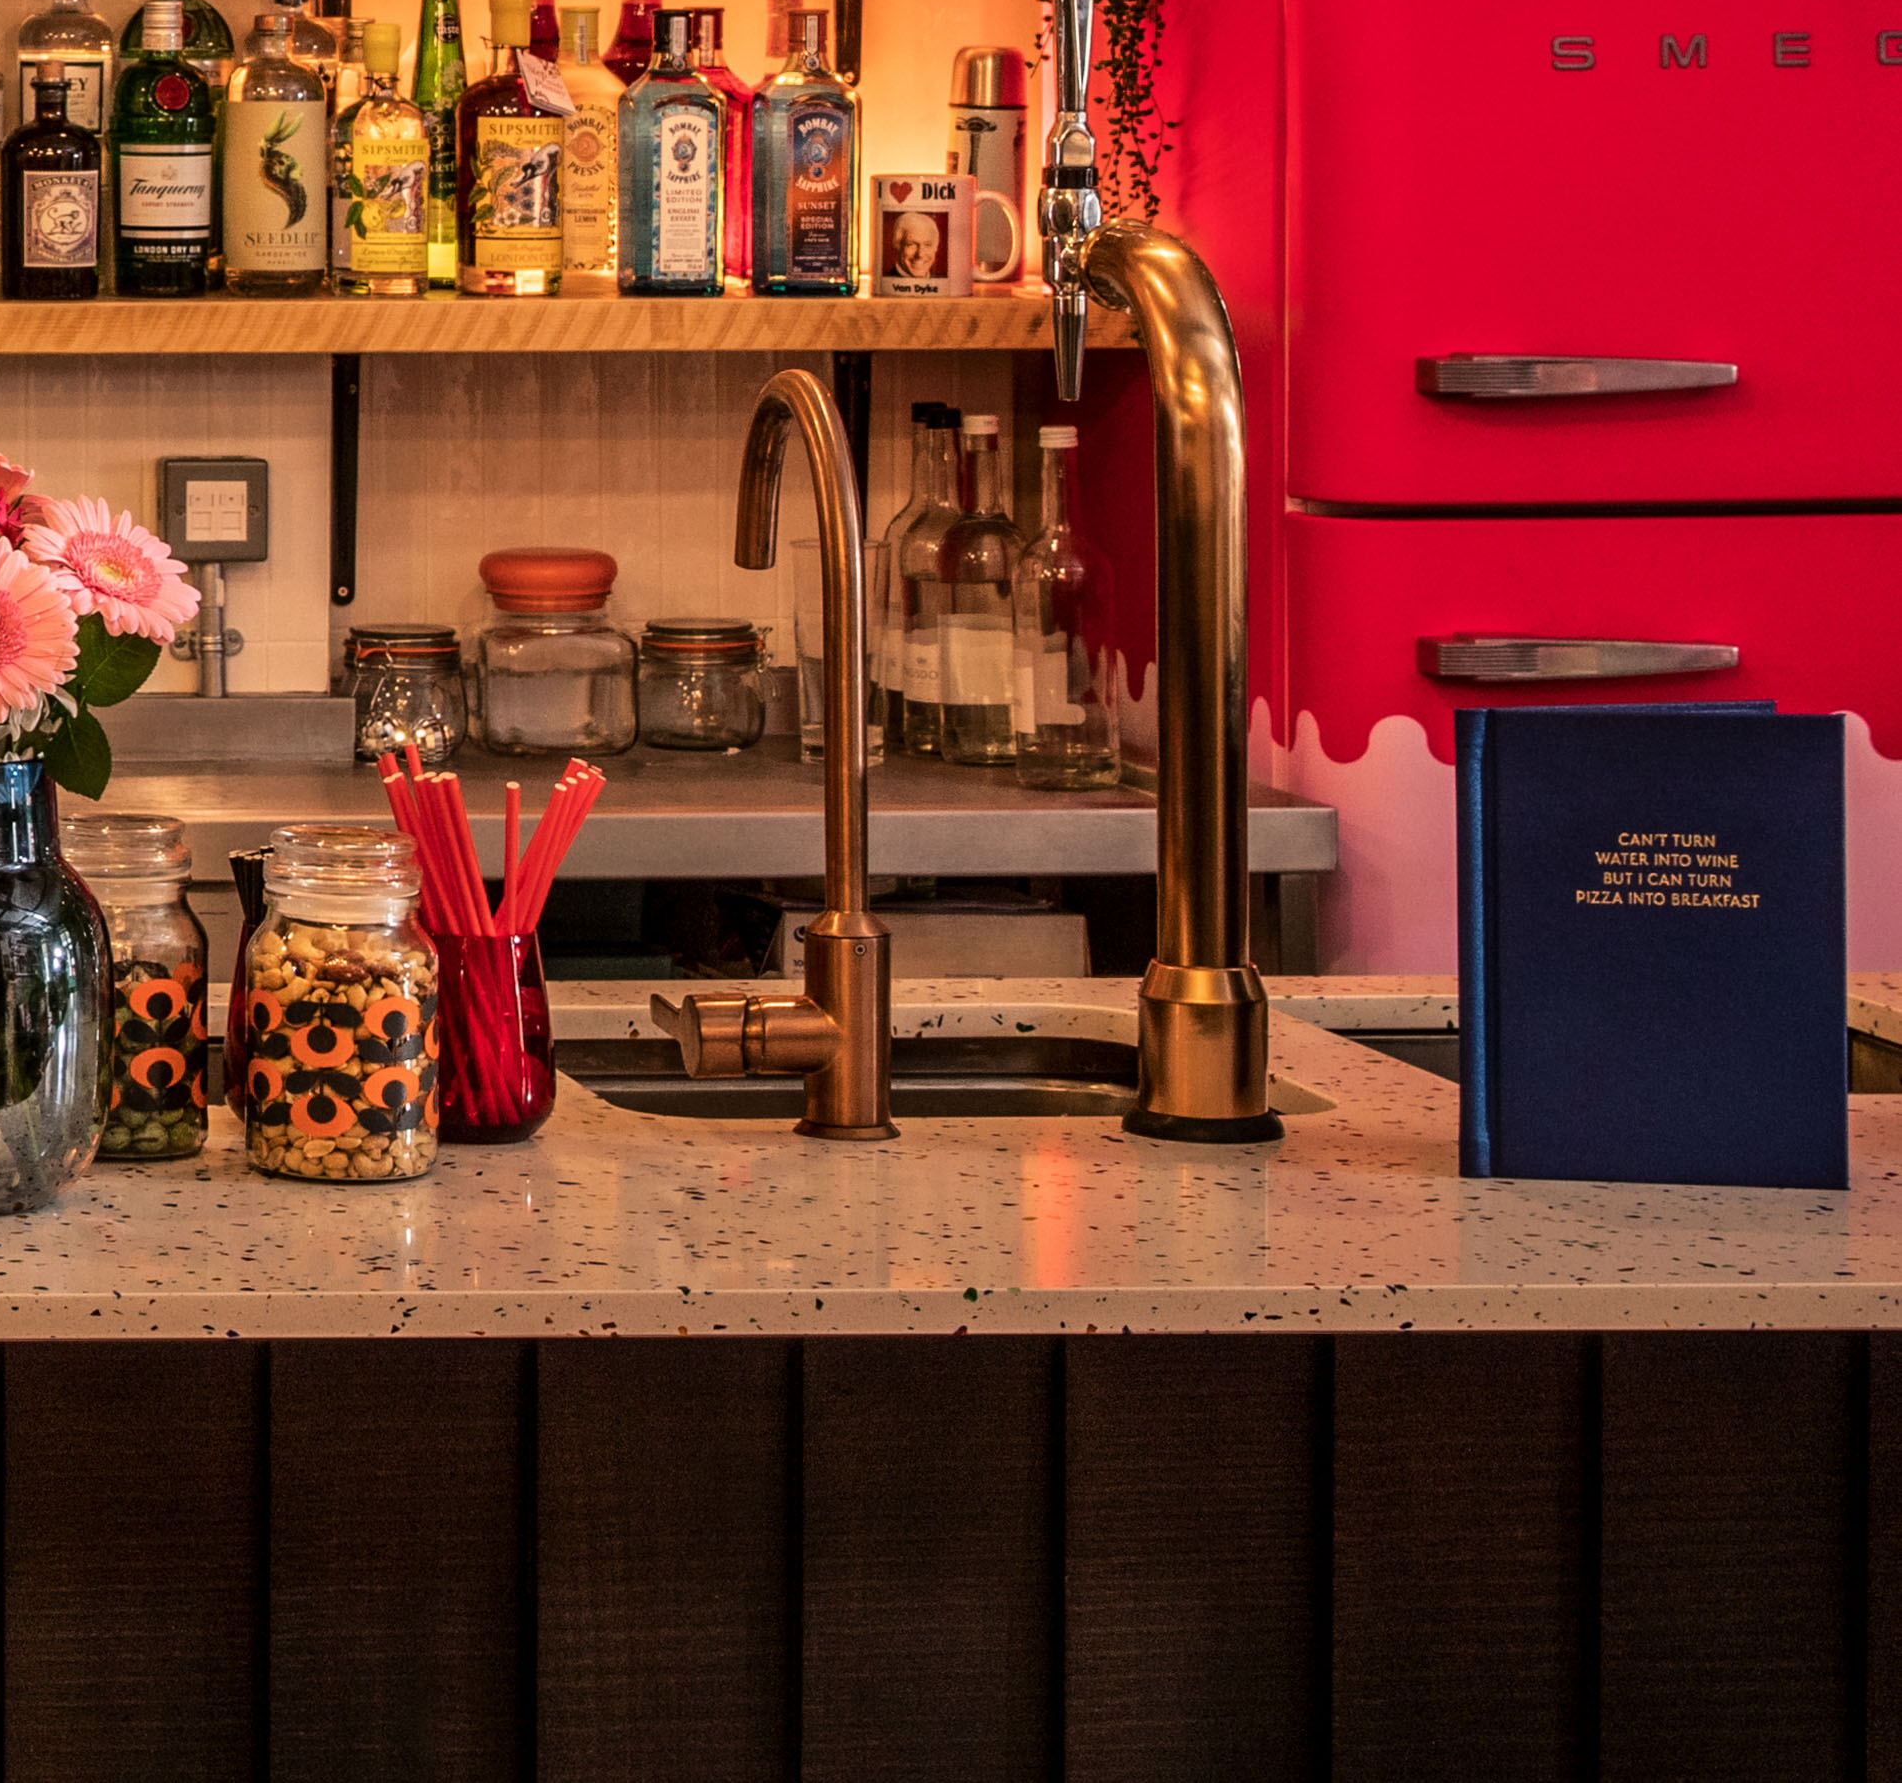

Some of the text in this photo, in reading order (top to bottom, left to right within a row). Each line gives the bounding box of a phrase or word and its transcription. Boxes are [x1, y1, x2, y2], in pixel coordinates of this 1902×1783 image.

[1551, 30, 1902, 71] SMEG
[488, 123, 562, 137] SIPSMITH
[566, 117, 607, 136] BOMBAY
[667, 120, 701, 137] BOMBAY
[796, 118, 839, 138] BOMBAY
[360, 144, 425, 157] SIPSMITH
[666, 170, 703, 185] SAPPHIRE
[128, 176, 208, 200] Tanqueray
[665, 189, 702, 197] LIMITED
[794, 177, 840, 197] SAPPHIRE
[878, 181, 956, 201] I Dick
[665, 198, 702, 206] EDITION
[796, 200, 838, 211] SUNSET
[666, 207, 700, 215] ENGLISH
[574, 216, 597, 224] LEMON
[799, 223, 836, 231] EDITION
[243, 229, 319, 248] SEEDLIP
[133, 245, 202, 255] LONDON DRY GIN
[892, 283, 938, 296] Van Dyke
[1617, 832, 1716, 849] CAN'T TURN
[1594, 851, 1739, 869] WATER INTO WINE
[1602, 870, 1633, 886] BUT
[1646, 872, 1685, 887] CAN
[1687, 873, 1732, 888] TURN
[1574, 889, 1761, 909] PIZZA INTO BREAKFAST
